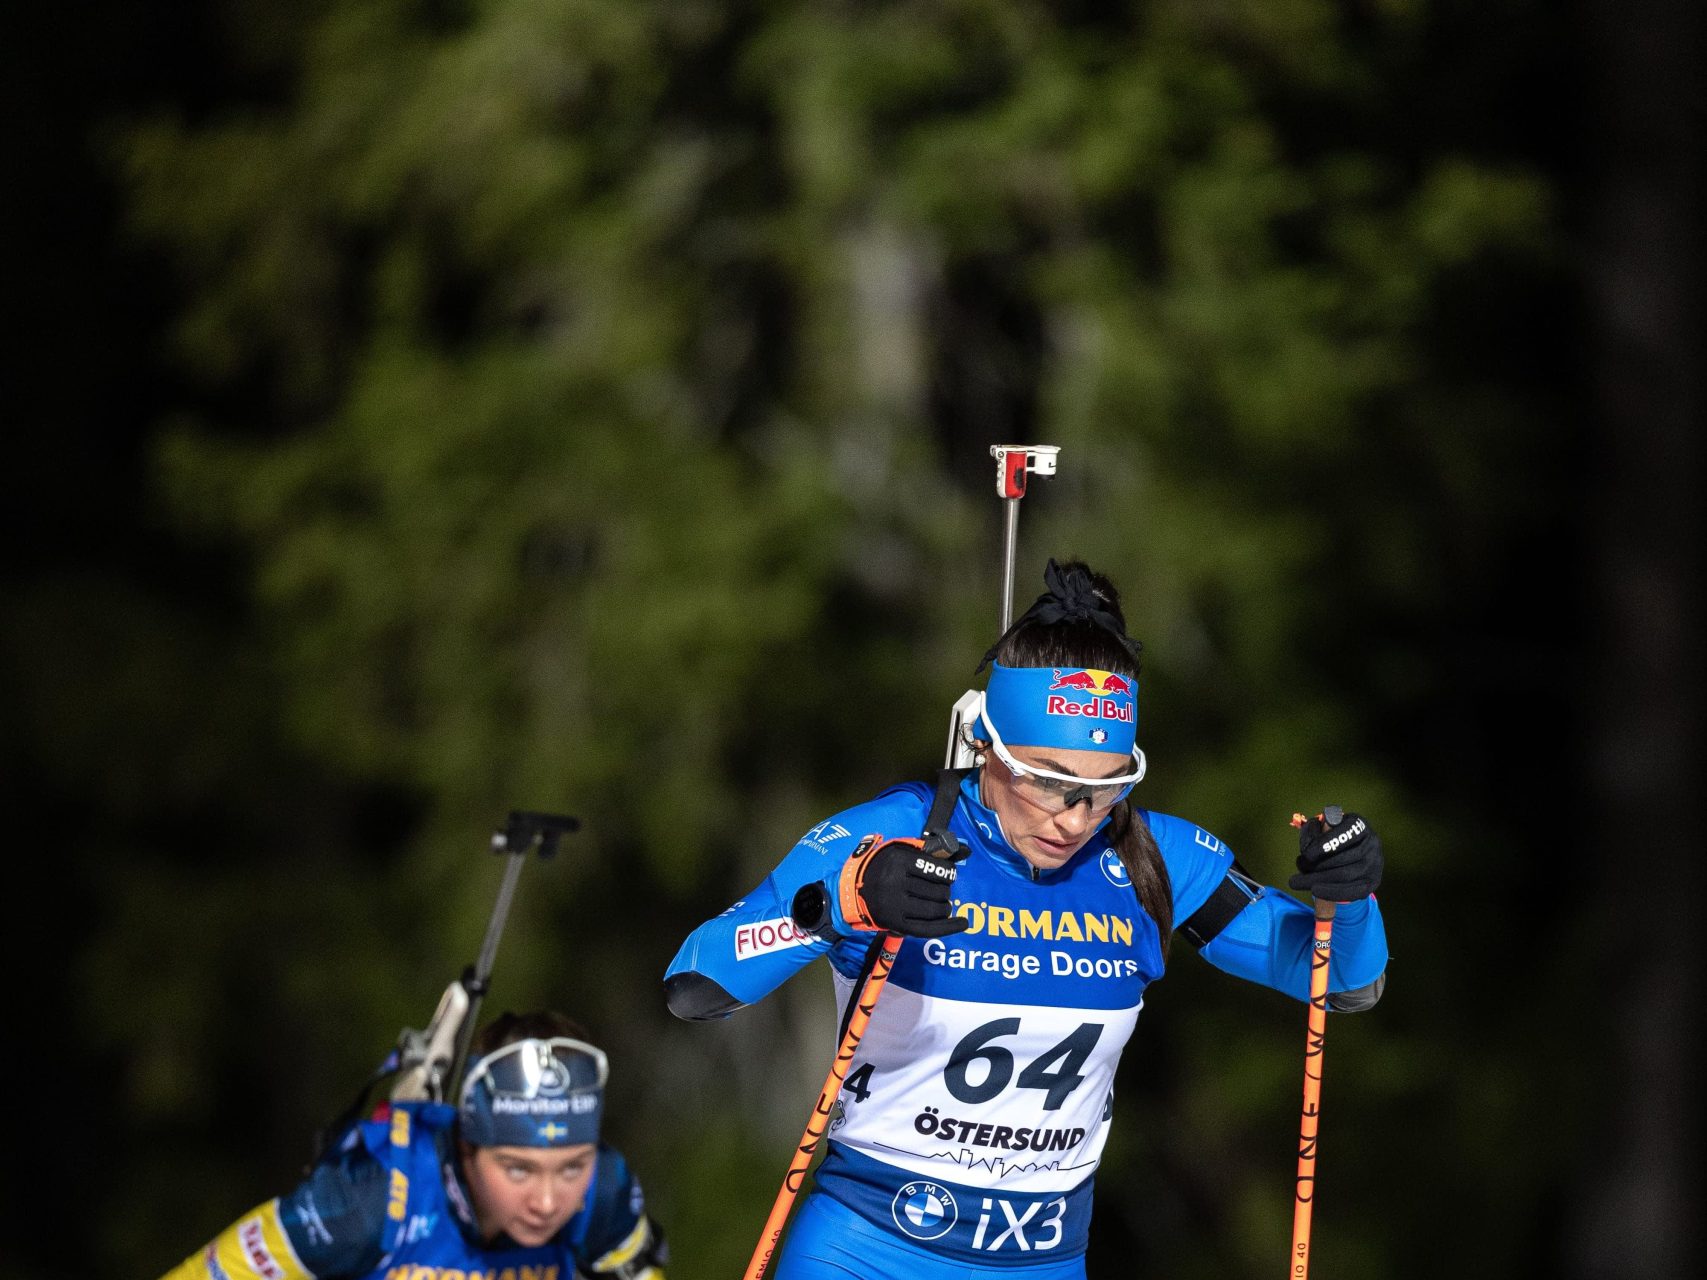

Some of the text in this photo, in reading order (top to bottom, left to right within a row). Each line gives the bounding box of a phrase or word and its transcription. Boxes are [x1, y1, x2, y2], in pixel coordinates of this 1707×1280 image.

[1047, 695, 1134, 723] Red Bull
[948, 899, 1133, 947] ÖRMANN
[923, 938, 1138, 979] Garage Doors
[943, 1017, 1105, 1111] 64
[913, 1106, 1086, 1152] ÖSTERSUND
[905, 1184, 952, 1207] BMW
[971, 1196, 1067, 1251] iX3
[1297, 1242, 1306, 1259] 40
